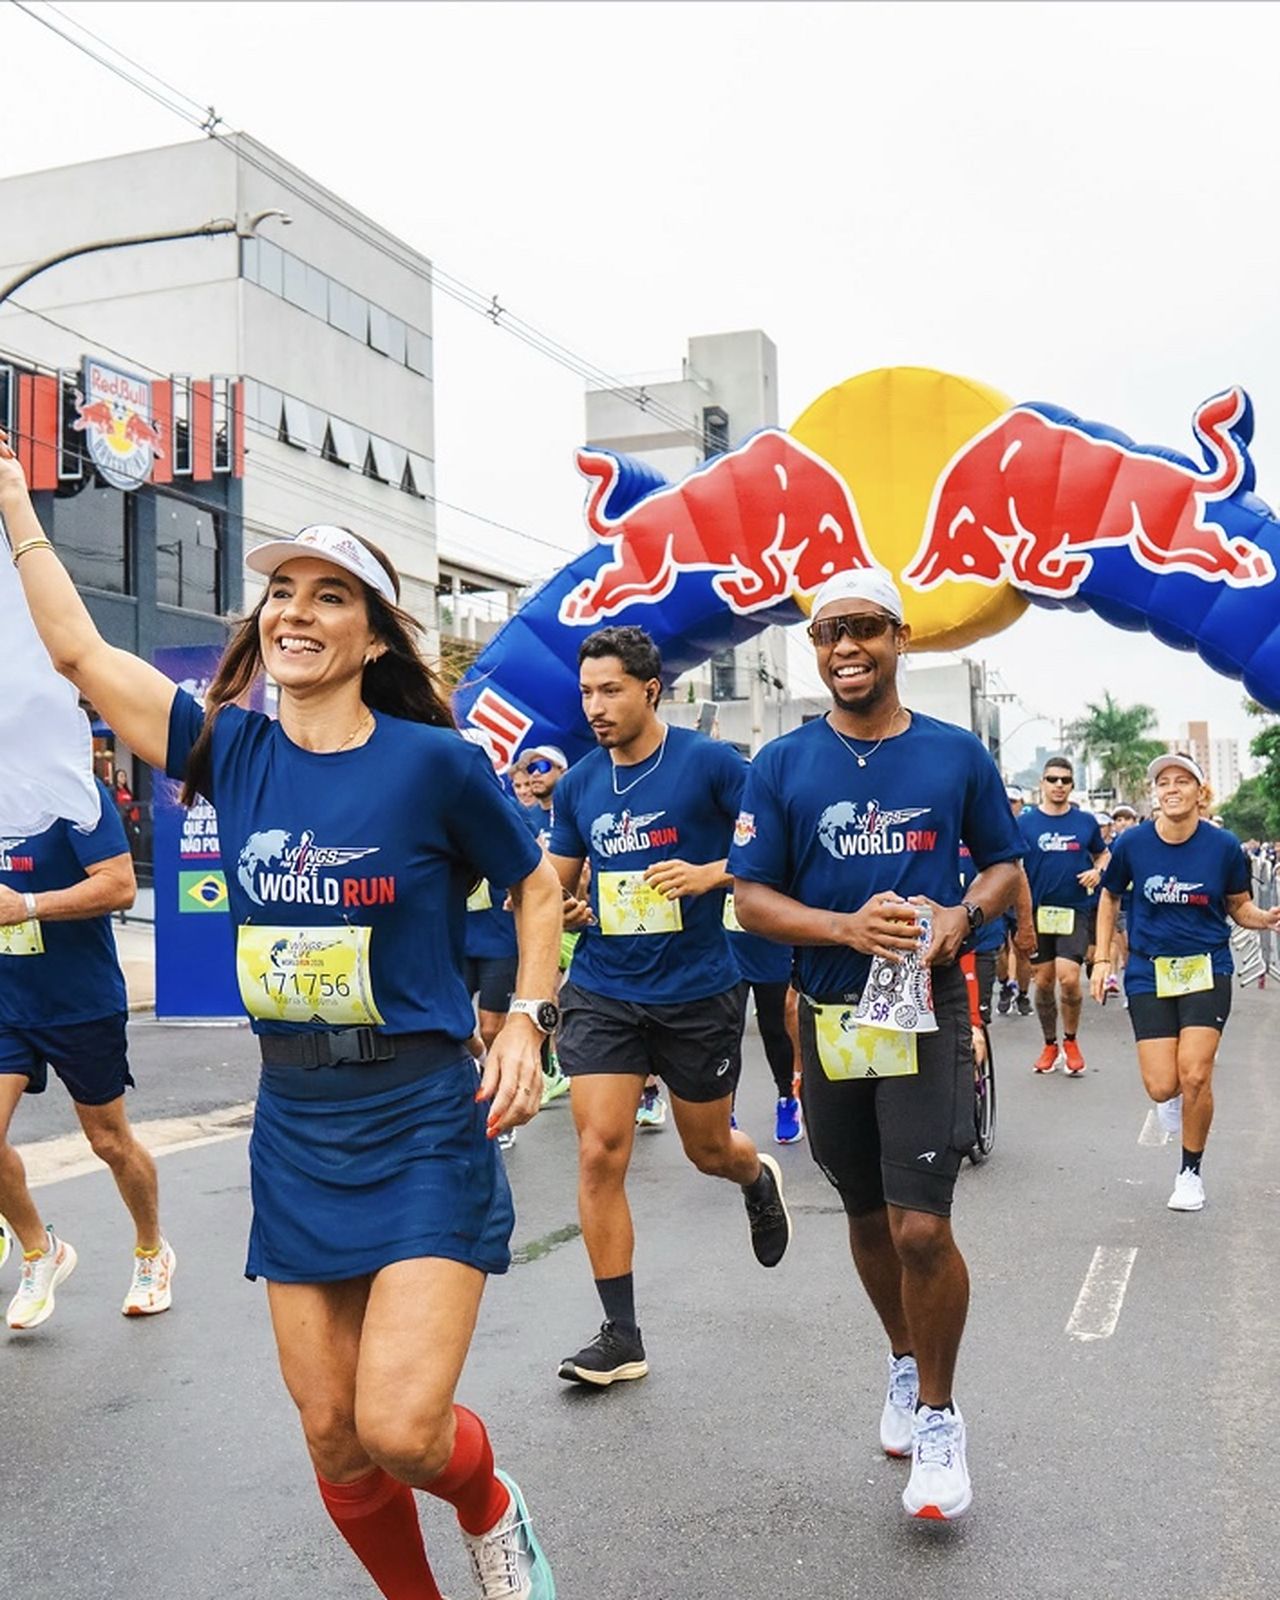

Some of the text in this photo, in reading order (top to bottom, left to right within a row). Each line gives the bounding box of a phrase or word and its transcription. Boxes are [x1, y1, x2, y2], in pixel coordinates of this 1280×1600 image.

[603, 827, 678, 855] WORLD RUN
[839, 832, 904, 856] WORLD
[905, 830, 937, 852] RUN
[258, 872, 395, 907] WORLD RUN
[259, 972, 351, 998] 171756
